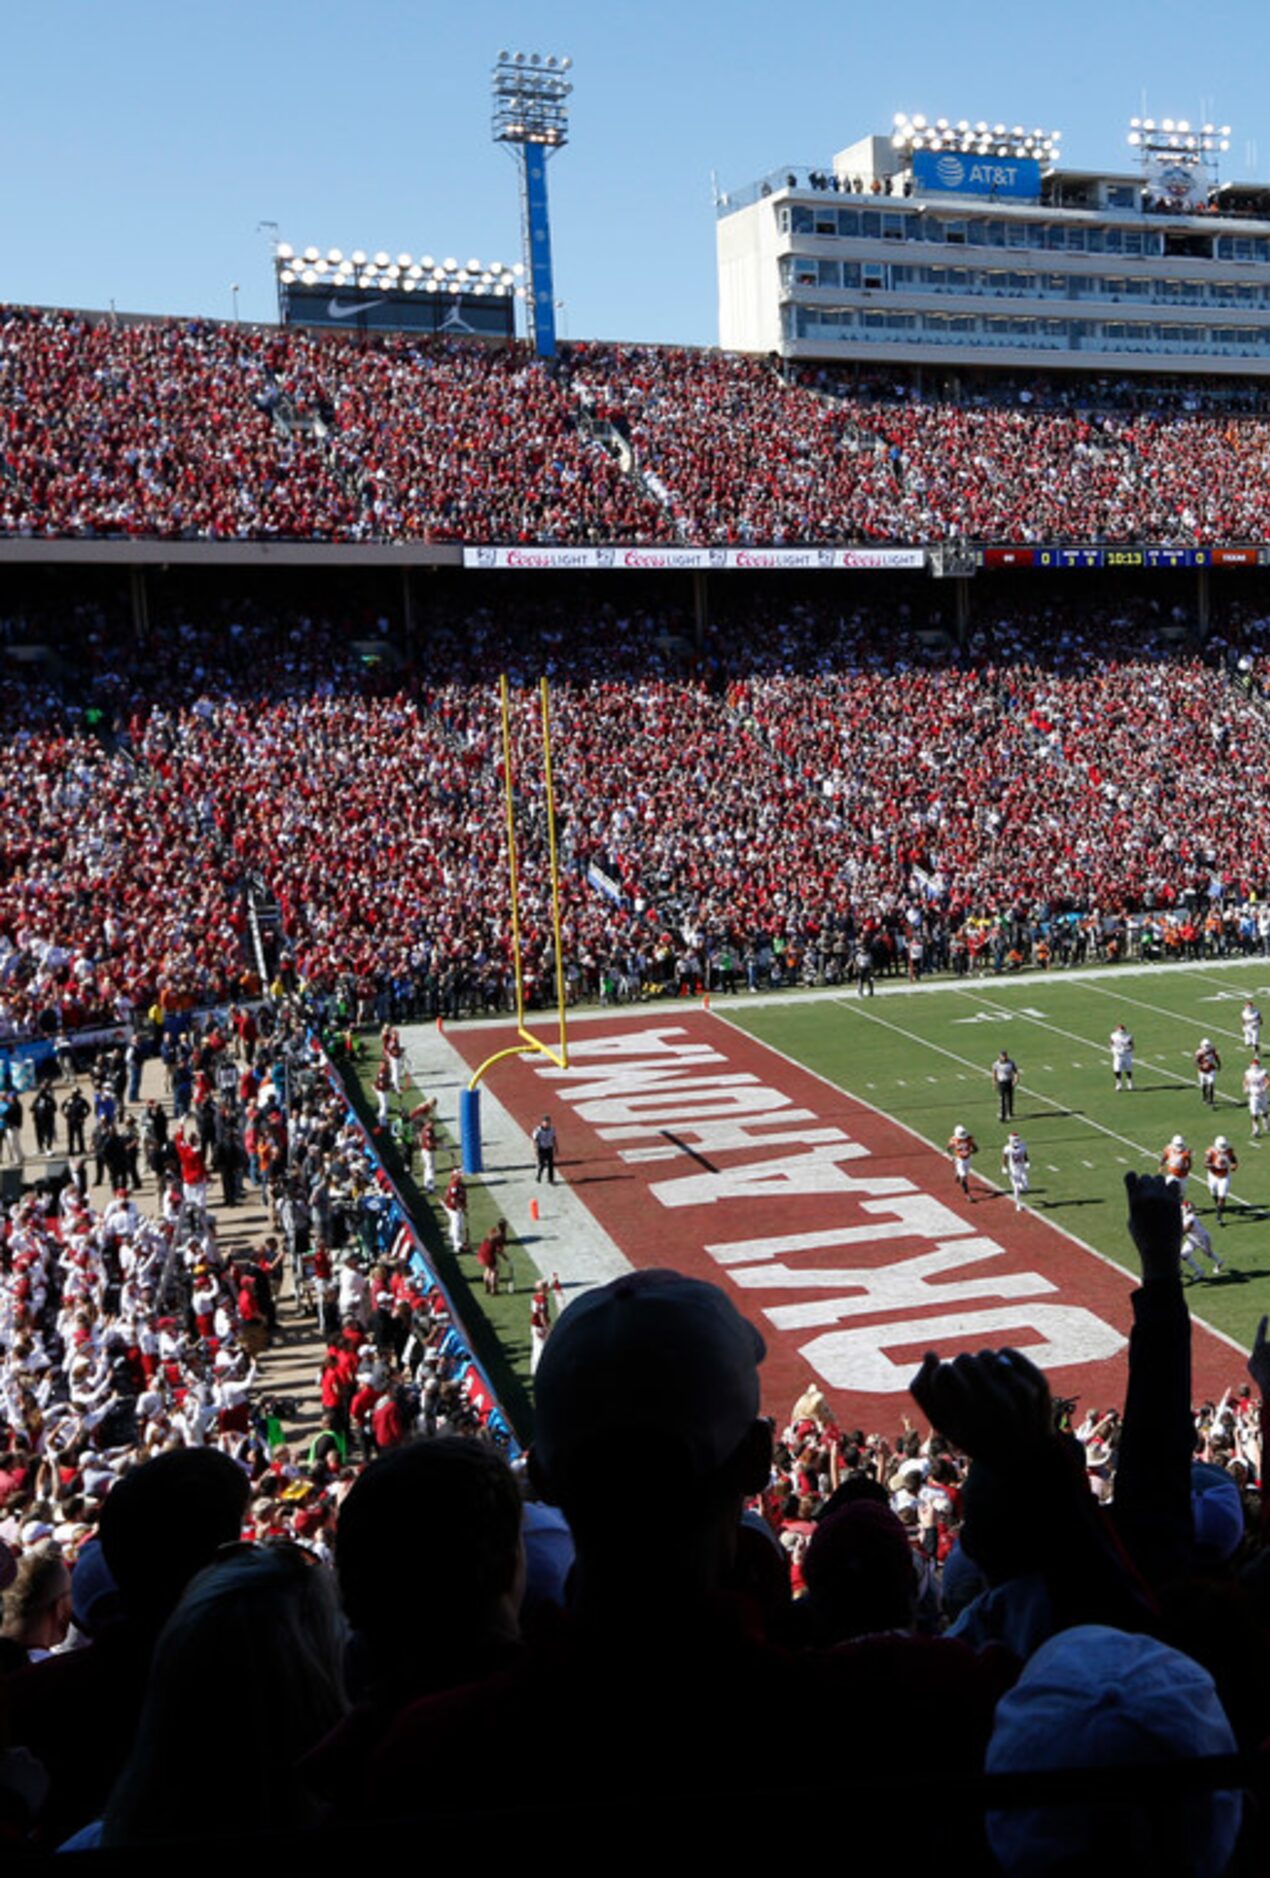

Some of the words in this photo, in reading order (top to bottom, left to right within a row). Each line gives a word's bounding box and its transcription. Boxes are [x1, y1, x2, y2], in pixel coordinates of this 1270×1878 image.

[969, 164, 1018, 186] AT&T
[506, 550, 549, 566] Coors
[551, 554, 588, 565] LIGHT
[624, 550, 665, 566] Coors
[667, 554, 700, 565] LIGHT
[777, 554, 810, 565] LIGHT
[1041, 552, 1051, 565] 0
[1108, 552, 1142, 564] 10:13
[1196, 552, 1205, 564] 0
[519, 1026, 1129, 1393] OKLAHOMA
